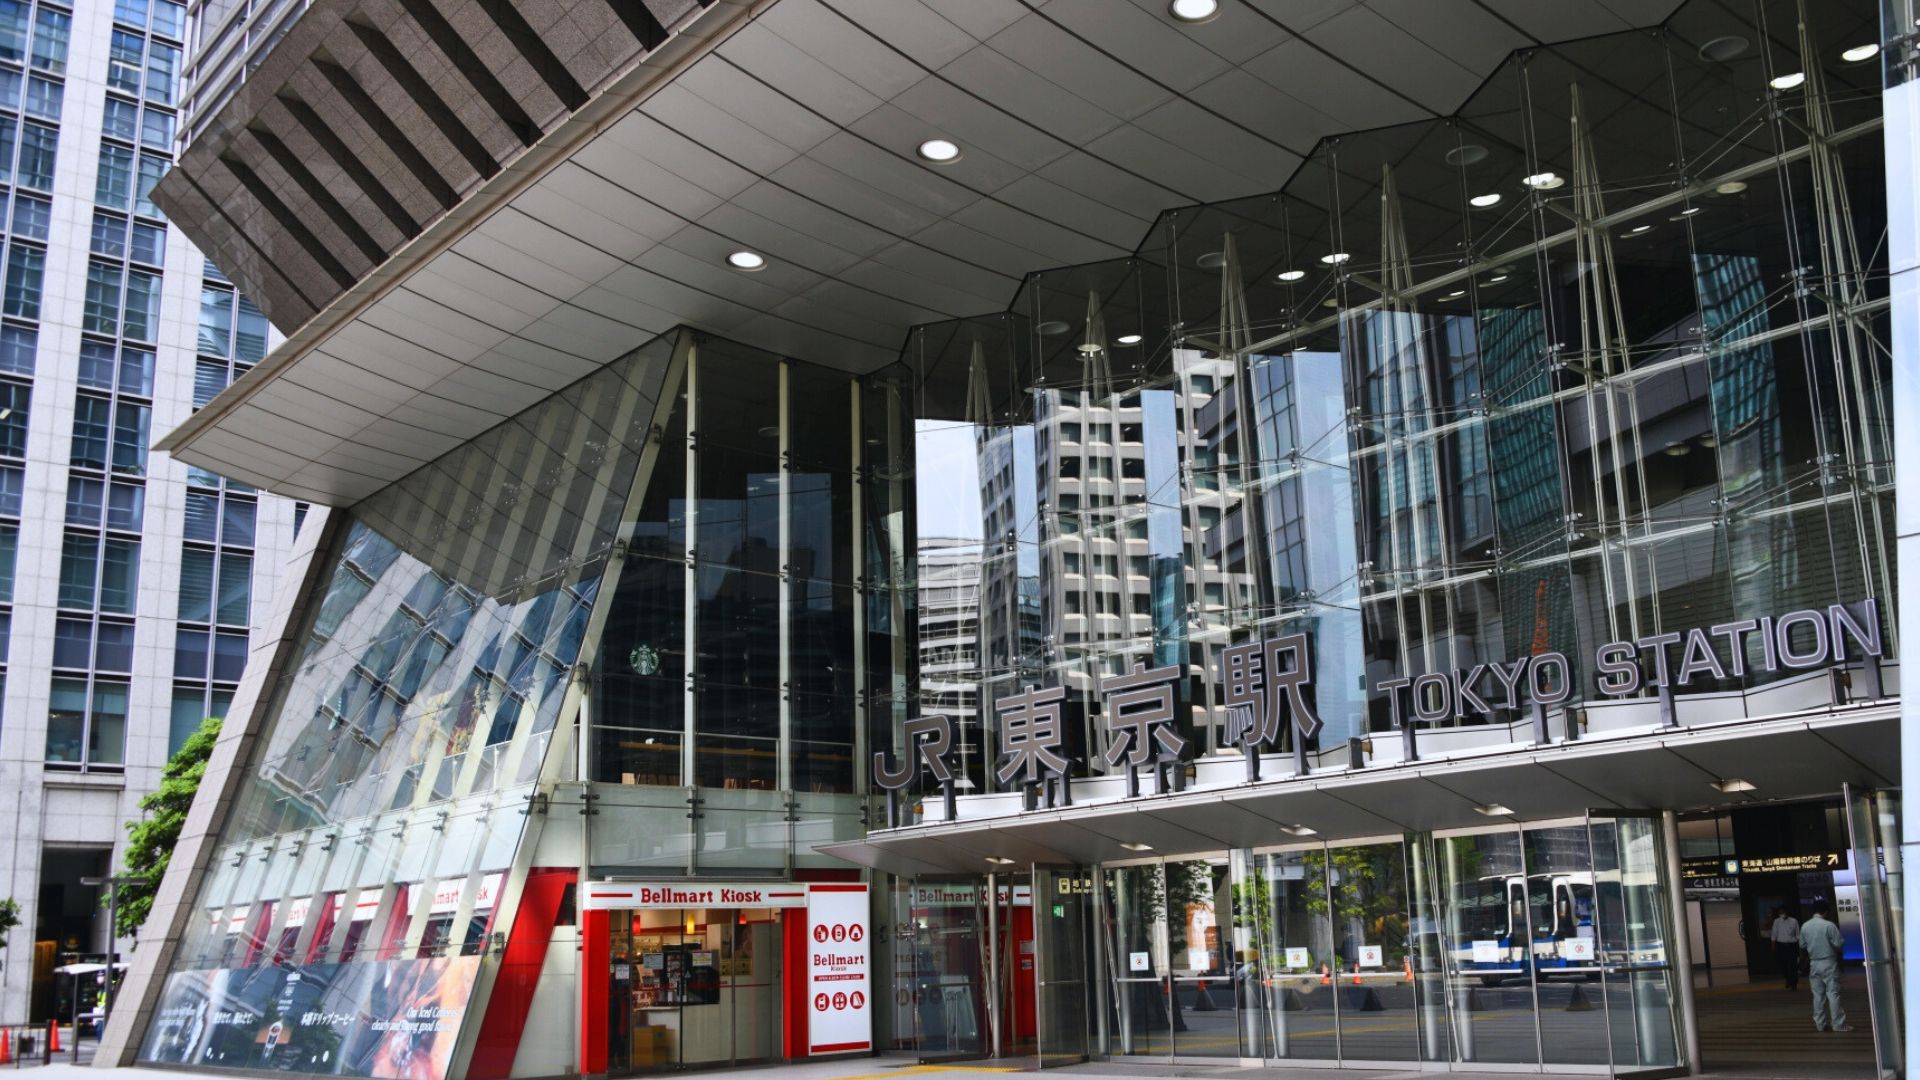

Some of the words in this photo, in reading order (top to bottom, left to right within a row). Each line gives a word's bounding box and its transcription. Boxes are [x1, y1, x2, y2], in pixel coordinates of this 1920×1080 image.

[1376, 651, 1577, 728] TOKYO
[1595, 597, 1885, 697] STATION
[640, 887, 714, 904] Bellmart
[721, 888, 762, 903] Kiosk
[918, 889, 975, 903] Bellmart
[979, 890, 1009, 903] Ksk
[813, 953, 865, 966] Bellmart
